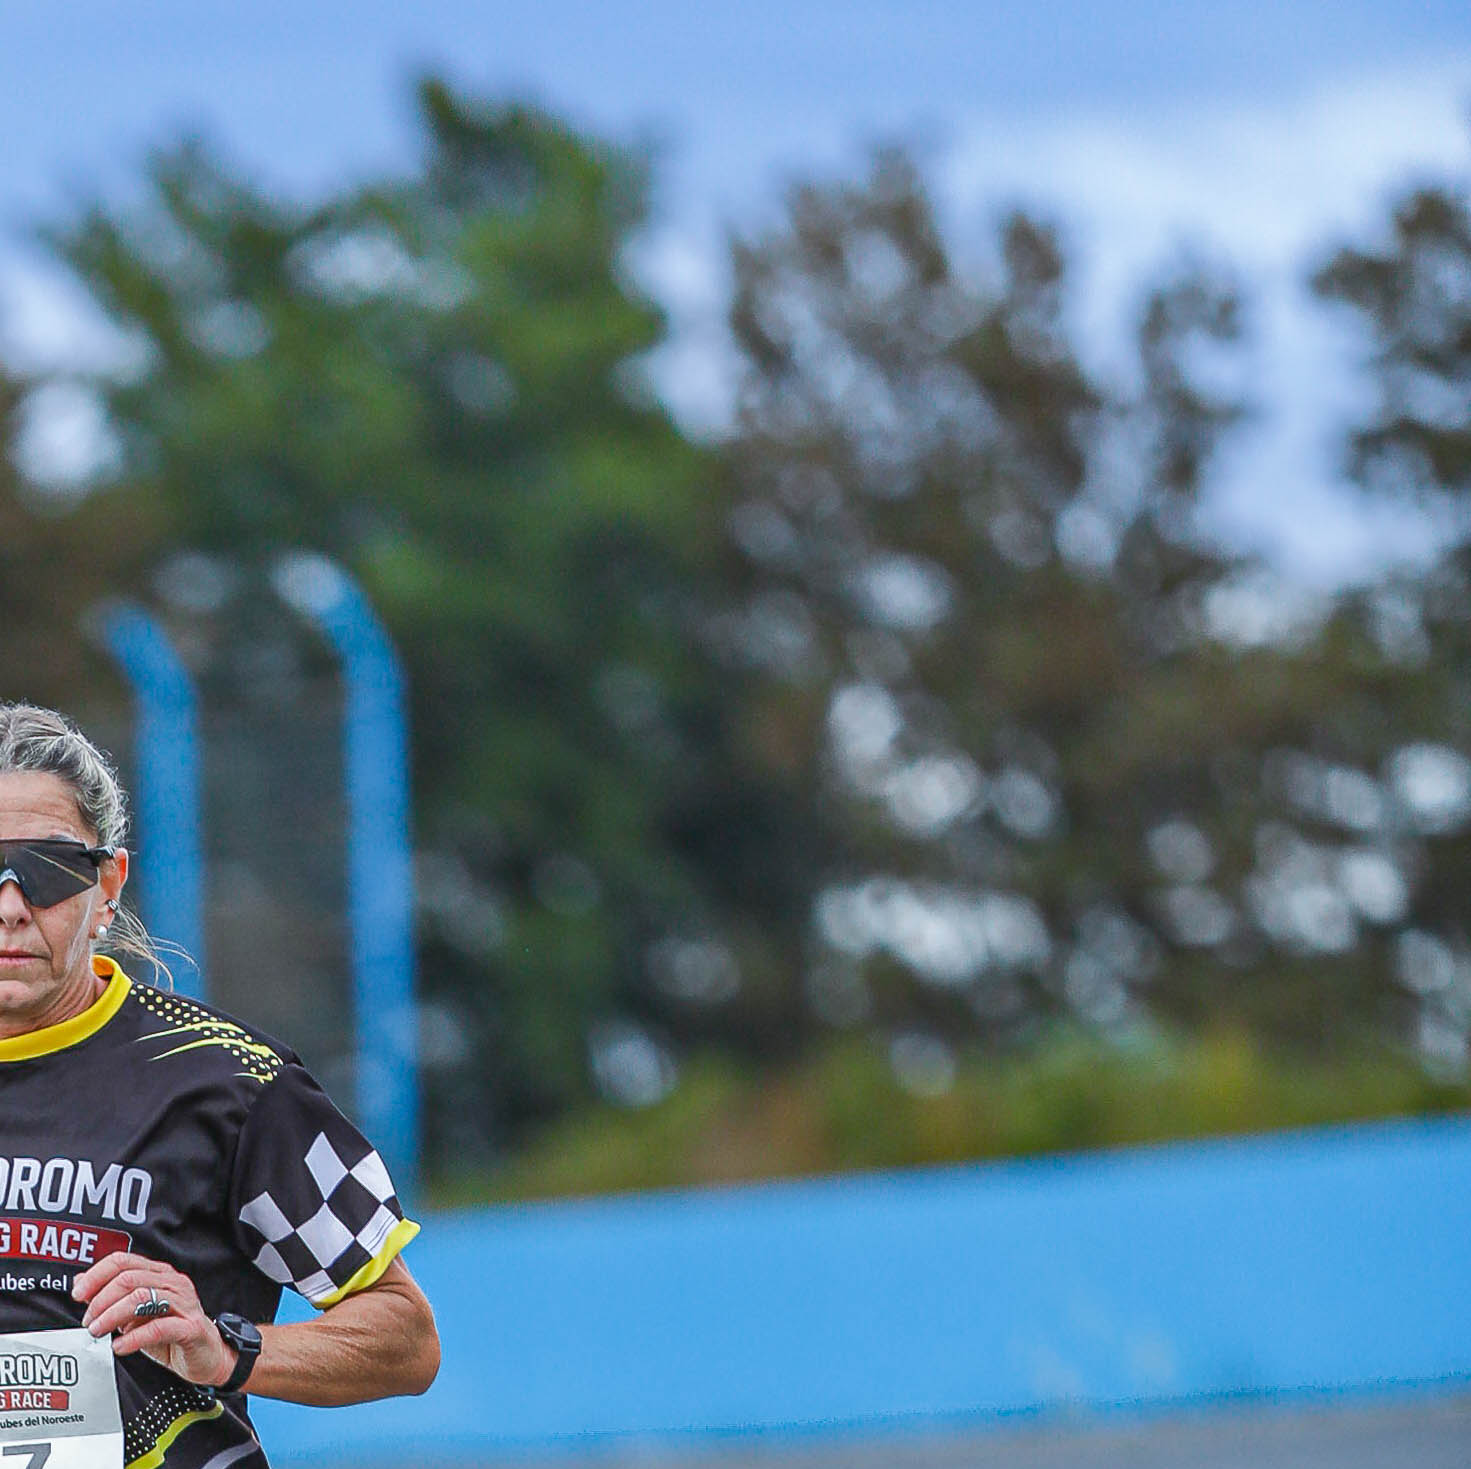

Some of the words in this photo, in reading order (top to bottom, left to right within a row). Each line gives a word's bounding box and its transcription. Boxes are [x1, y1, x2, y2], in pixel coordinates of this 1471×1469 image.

[20, 1223, 98, 1264] RACE
[40, 1273, 67, 1292] del
[11, 1390, 52, 1409] RACE
[25, 1416, 40, 1427] del
[42, 1413, 85, 1426] Noroeste
